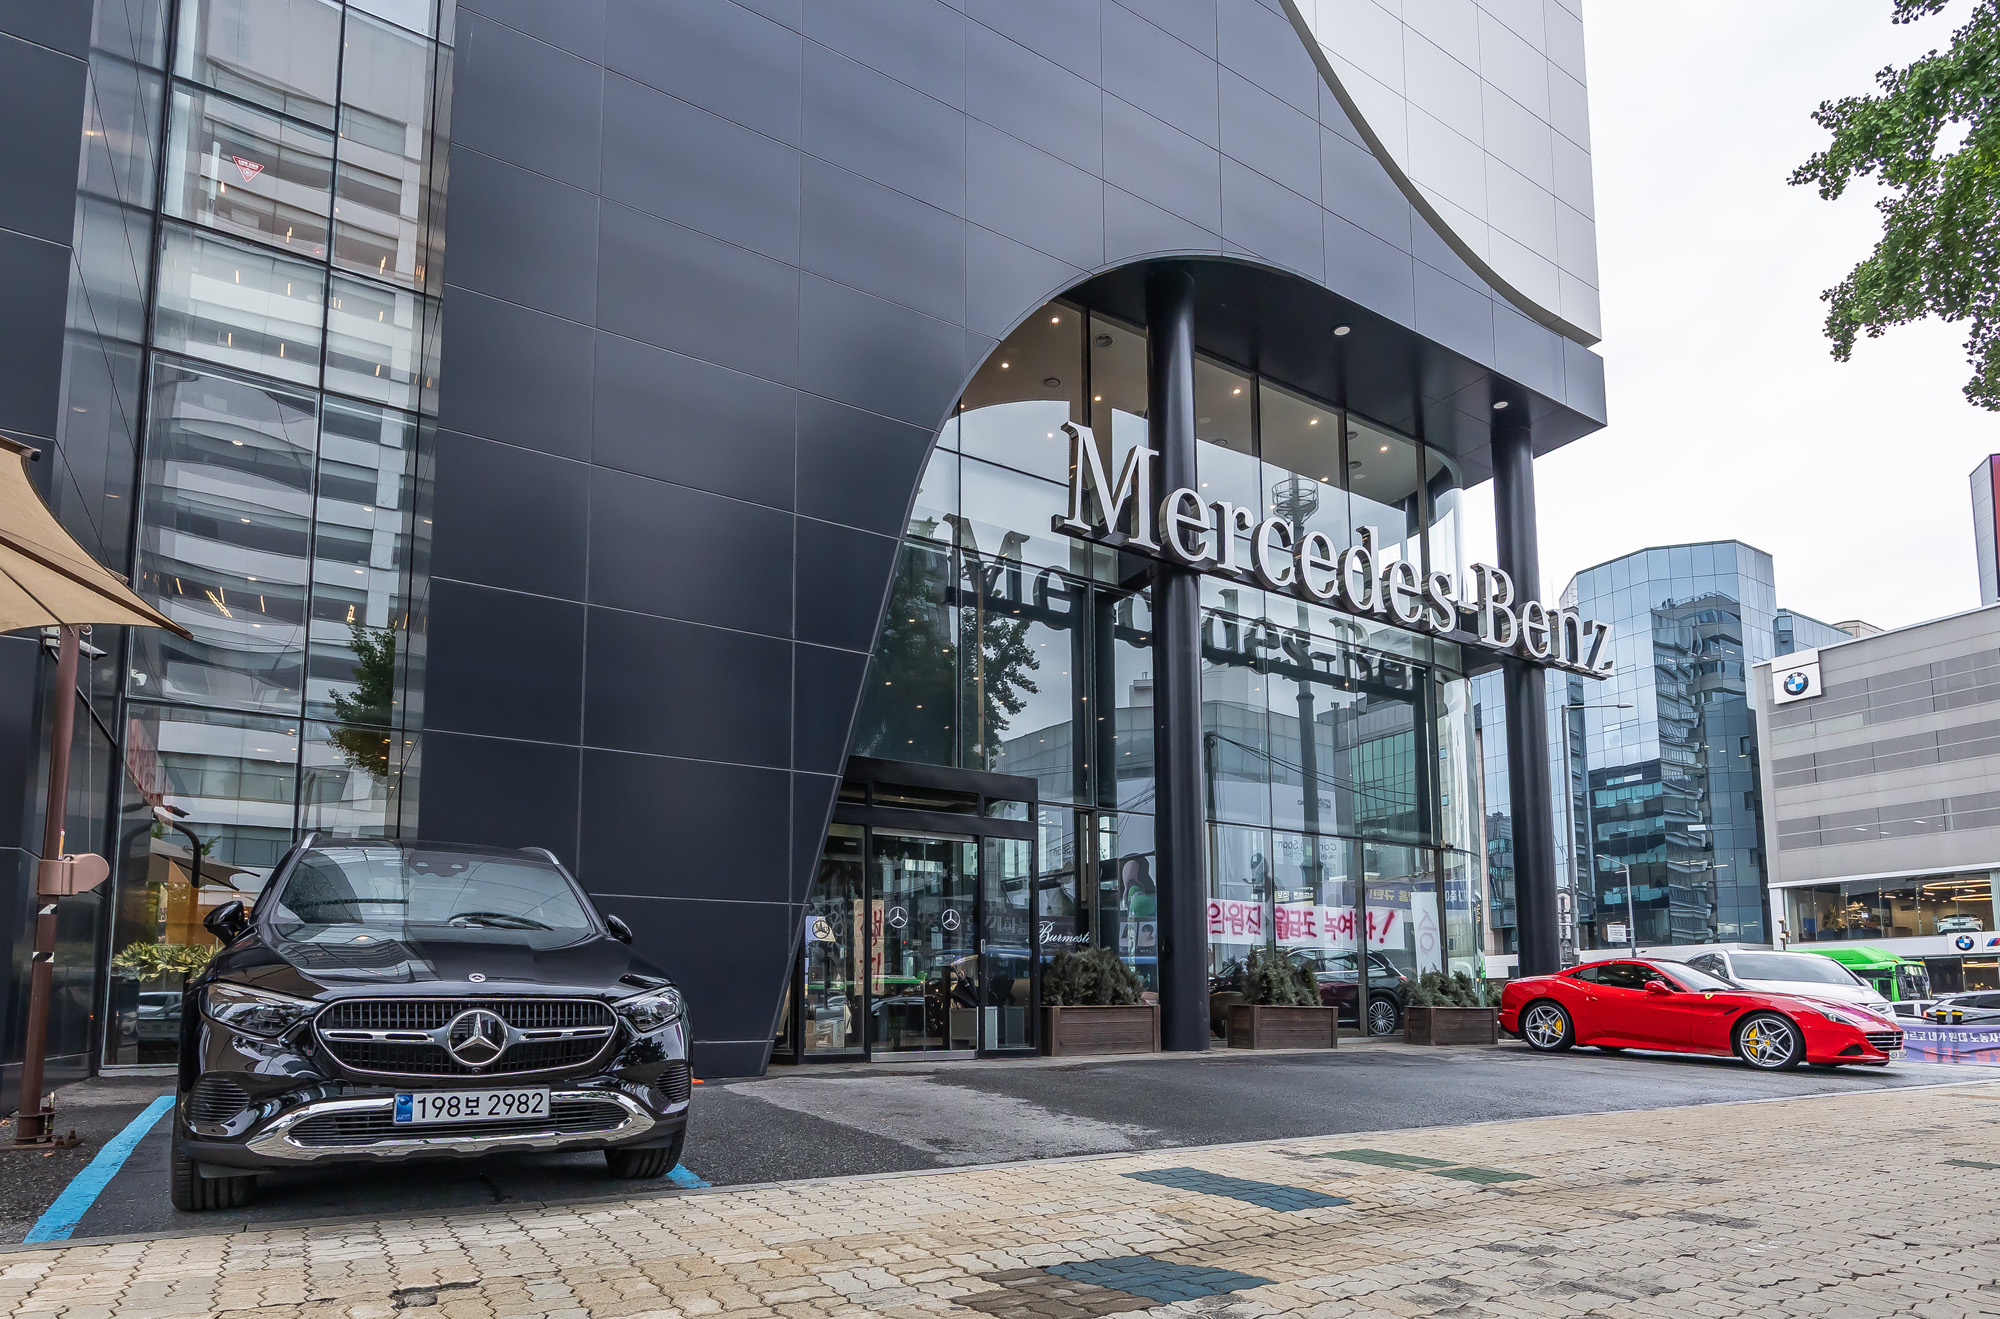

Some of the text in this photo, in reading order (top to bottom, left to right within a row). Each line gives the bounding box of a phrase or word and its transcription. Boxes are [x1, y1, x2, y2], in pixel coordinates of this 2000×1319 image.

[1052, 420, 1616, 679] Mercedes-Benz
[417, 1092, 544, 1119] 198보 2982
